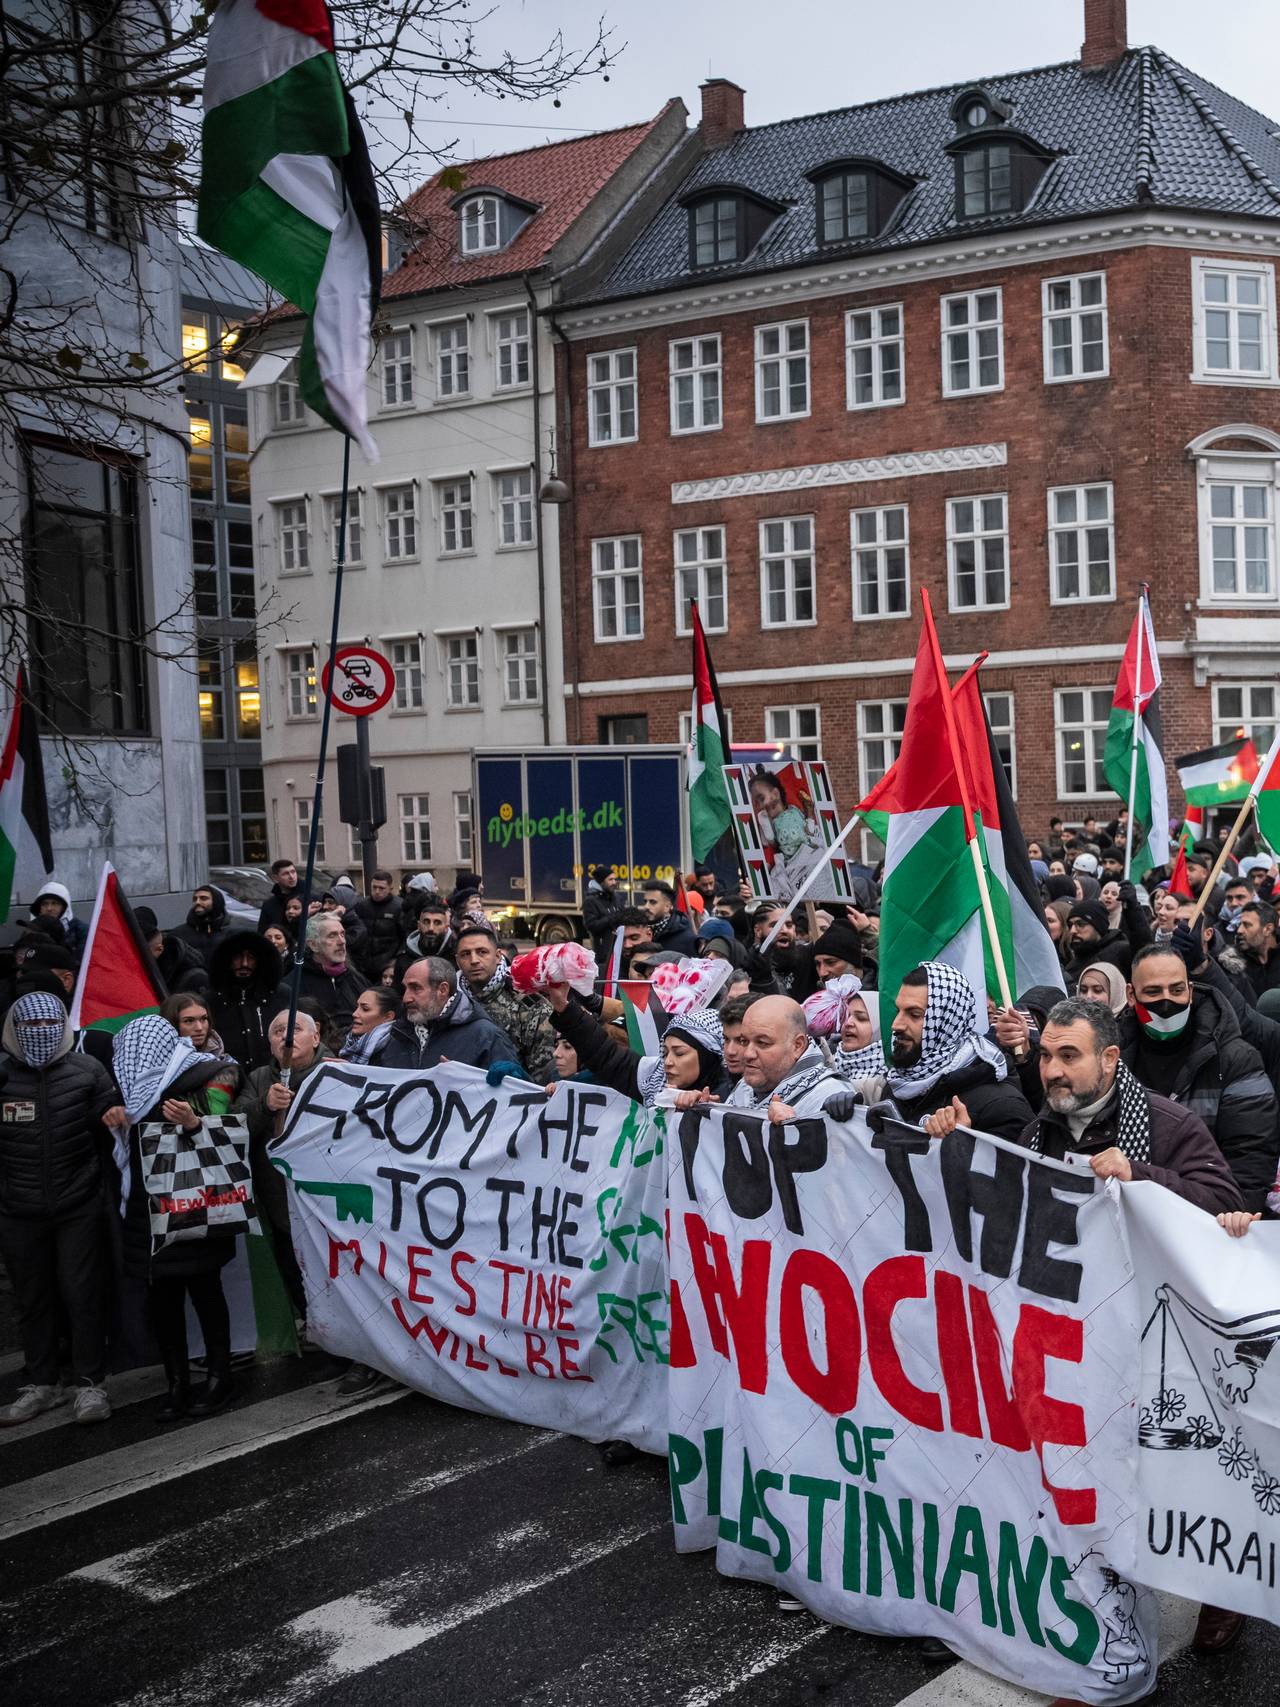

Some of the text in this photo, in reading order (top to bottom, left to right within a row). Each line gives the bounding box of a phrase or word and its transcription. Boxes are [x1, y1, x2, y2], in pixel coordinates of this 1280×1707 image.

[487, 800, 623, 848] flytbedst.dk
[633, 865, 651, 880] 60
[267, 1065, 498, 1170] FROM
[508, 1088, 607, 1173] THE
[377, 1167, 467, 1250] TO
[486, 1177, 583, 1269] THE
[667, 1107, 828, 1236] TOP
[871, 1117, 1098, 1303] THE
[525, 1332, 594, 1383] BE
[835, 1417, 895, 1482] OF
